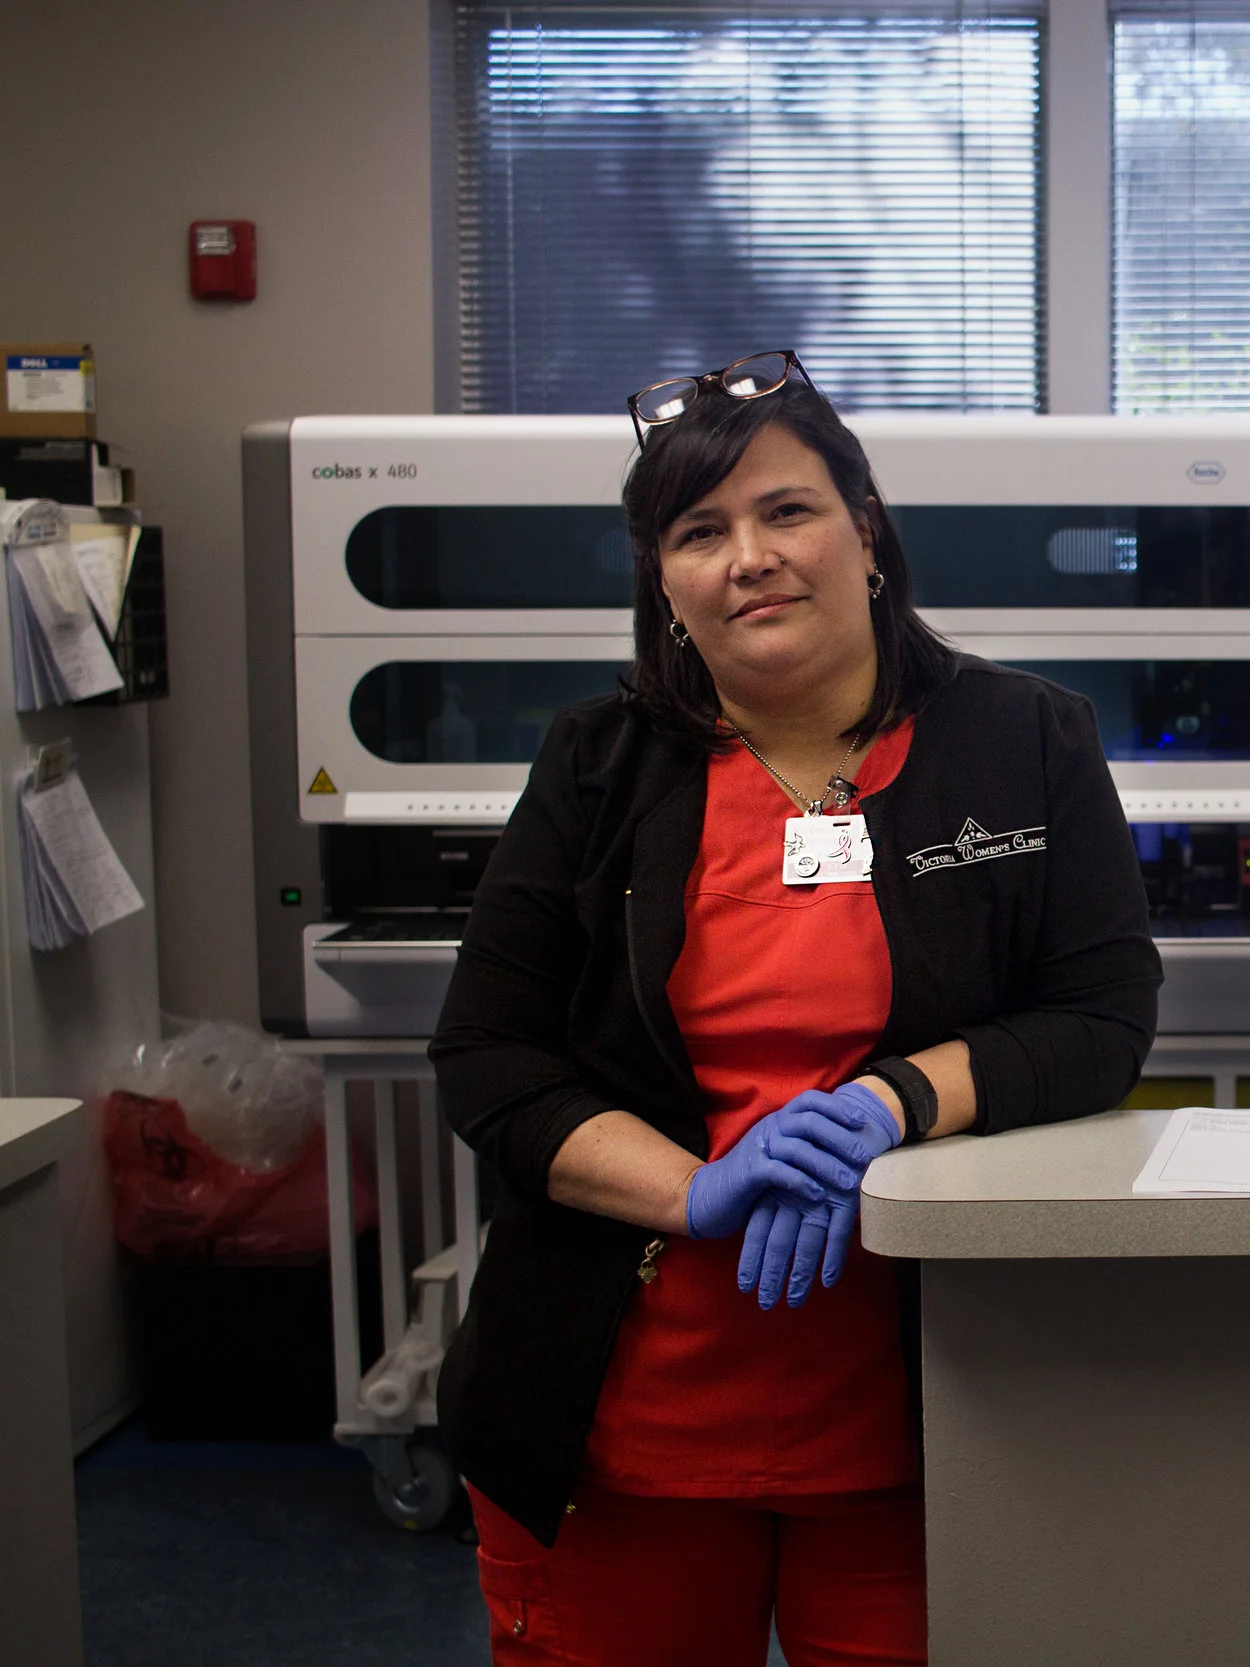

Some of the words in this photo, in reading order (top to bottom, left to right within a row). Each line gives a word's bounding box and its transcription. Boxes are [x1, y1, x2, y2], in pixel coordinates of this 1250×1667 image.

[312, 462, 362, 479] cobas
[368, 467, 378, 479] x
[387, 463, 418, 479] 480
[1013, 834, 1046, 850] CLINIC
